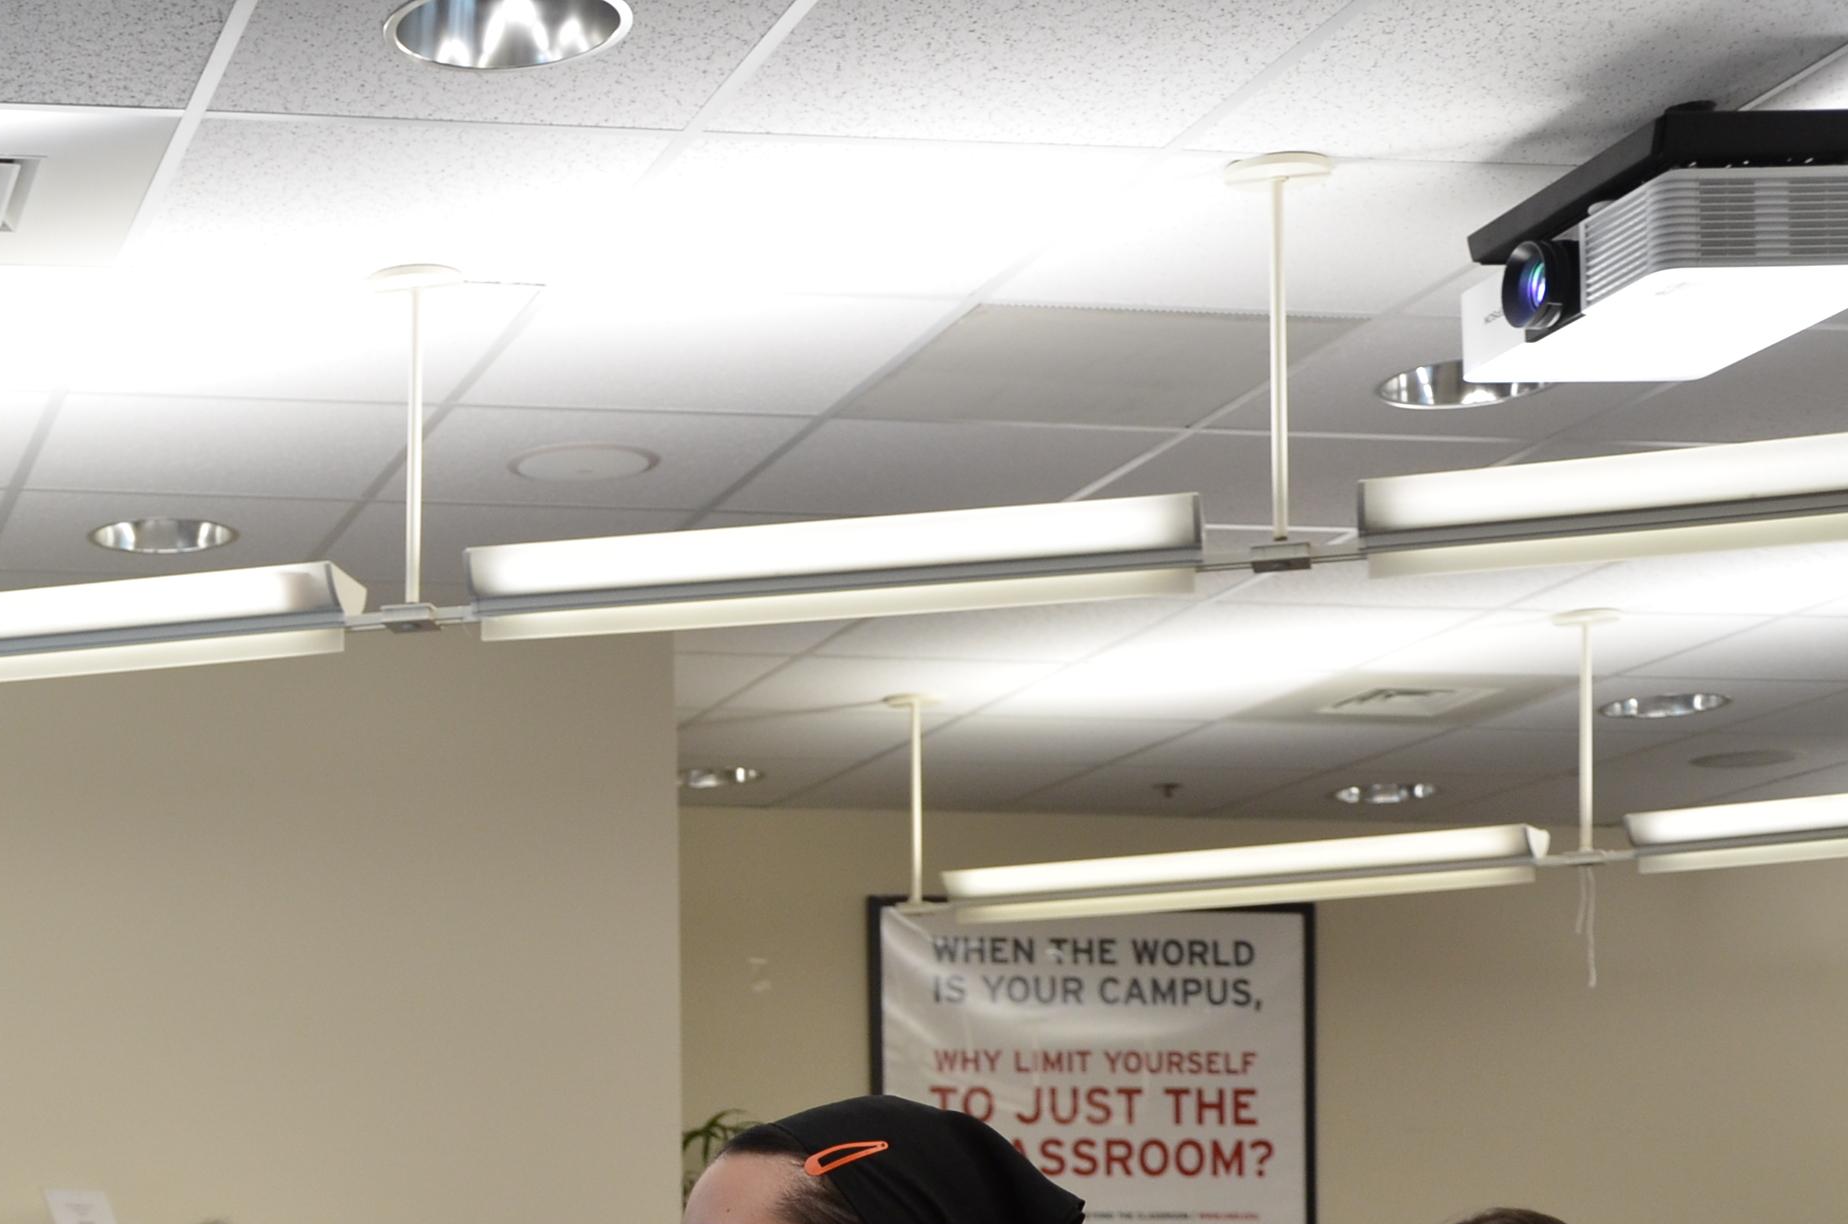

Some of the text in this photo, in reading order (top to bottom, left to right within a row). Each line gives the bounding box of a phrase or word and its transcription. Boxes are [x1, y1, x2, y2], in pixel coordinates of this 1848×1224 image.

[932, 936, 1256, 967] WHEN THE WORLD
[934, 976, 1263, 1012] IS YOUR CAMPUS,
[935, 1049, 1257, 1075] WHY LIMIT YOURSELF
[930, 1086, 1259, 1126] TO JUST THE
